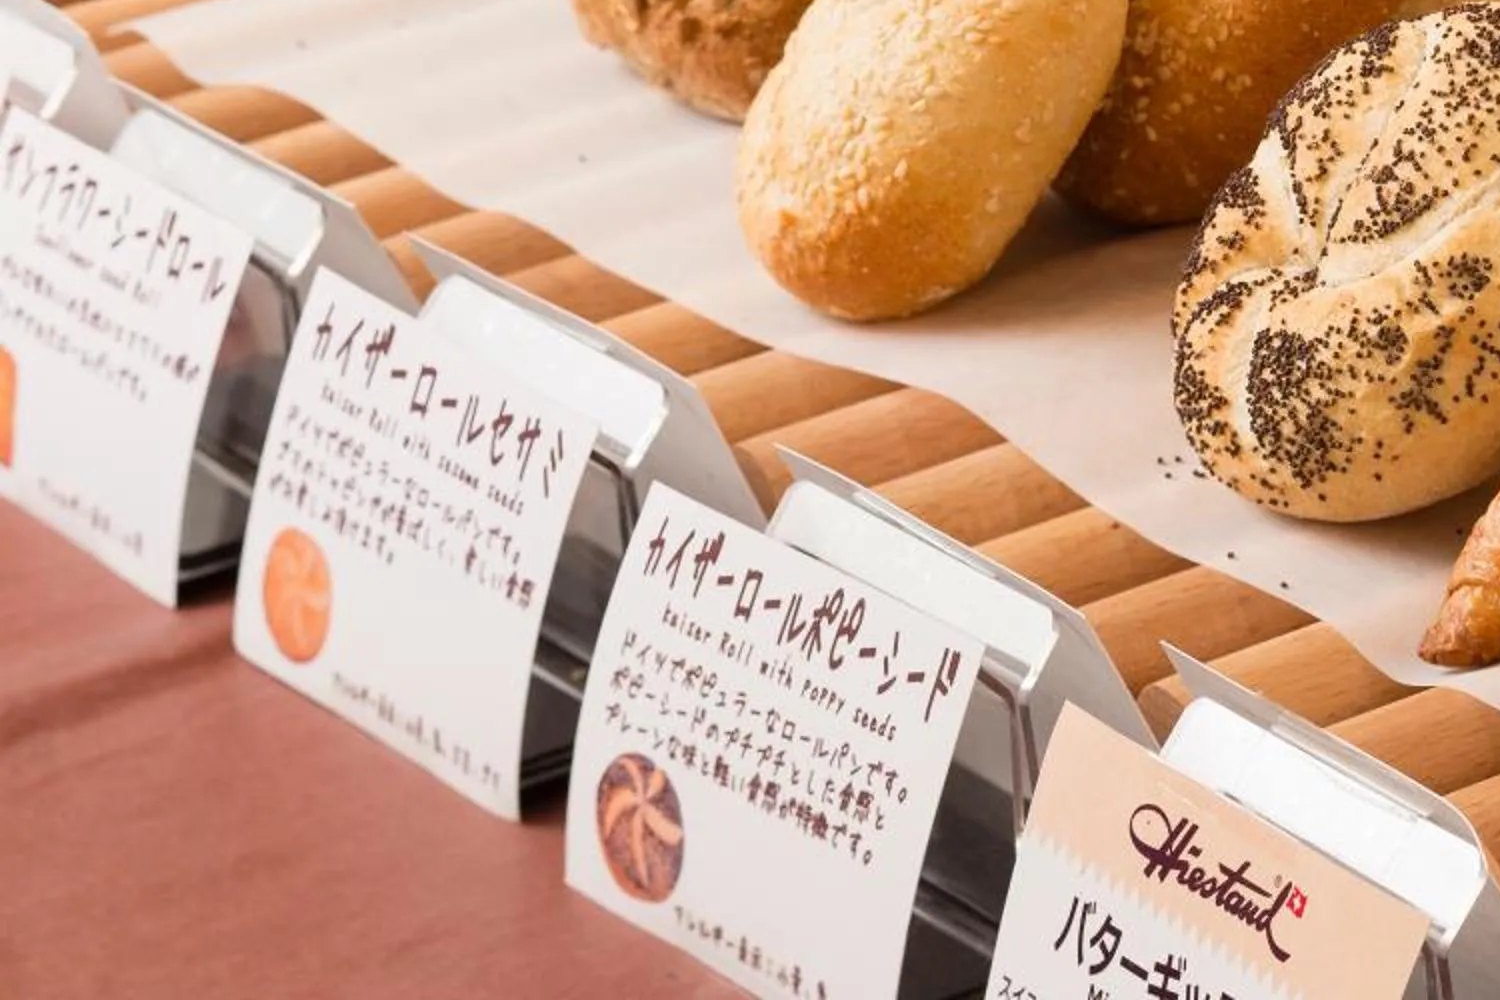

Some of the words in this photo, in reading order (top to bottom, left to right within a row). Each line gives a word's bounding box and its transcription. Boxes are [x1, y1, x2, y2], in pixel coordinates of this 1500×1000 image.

[312, 301, 565, 499] カイザーロールセサミ
[643, 516, 962, 723] カイザーロールポピーシード
[852, 706, 897, 742] seeds
[1129, 803, 1292, 963] Hiestand
